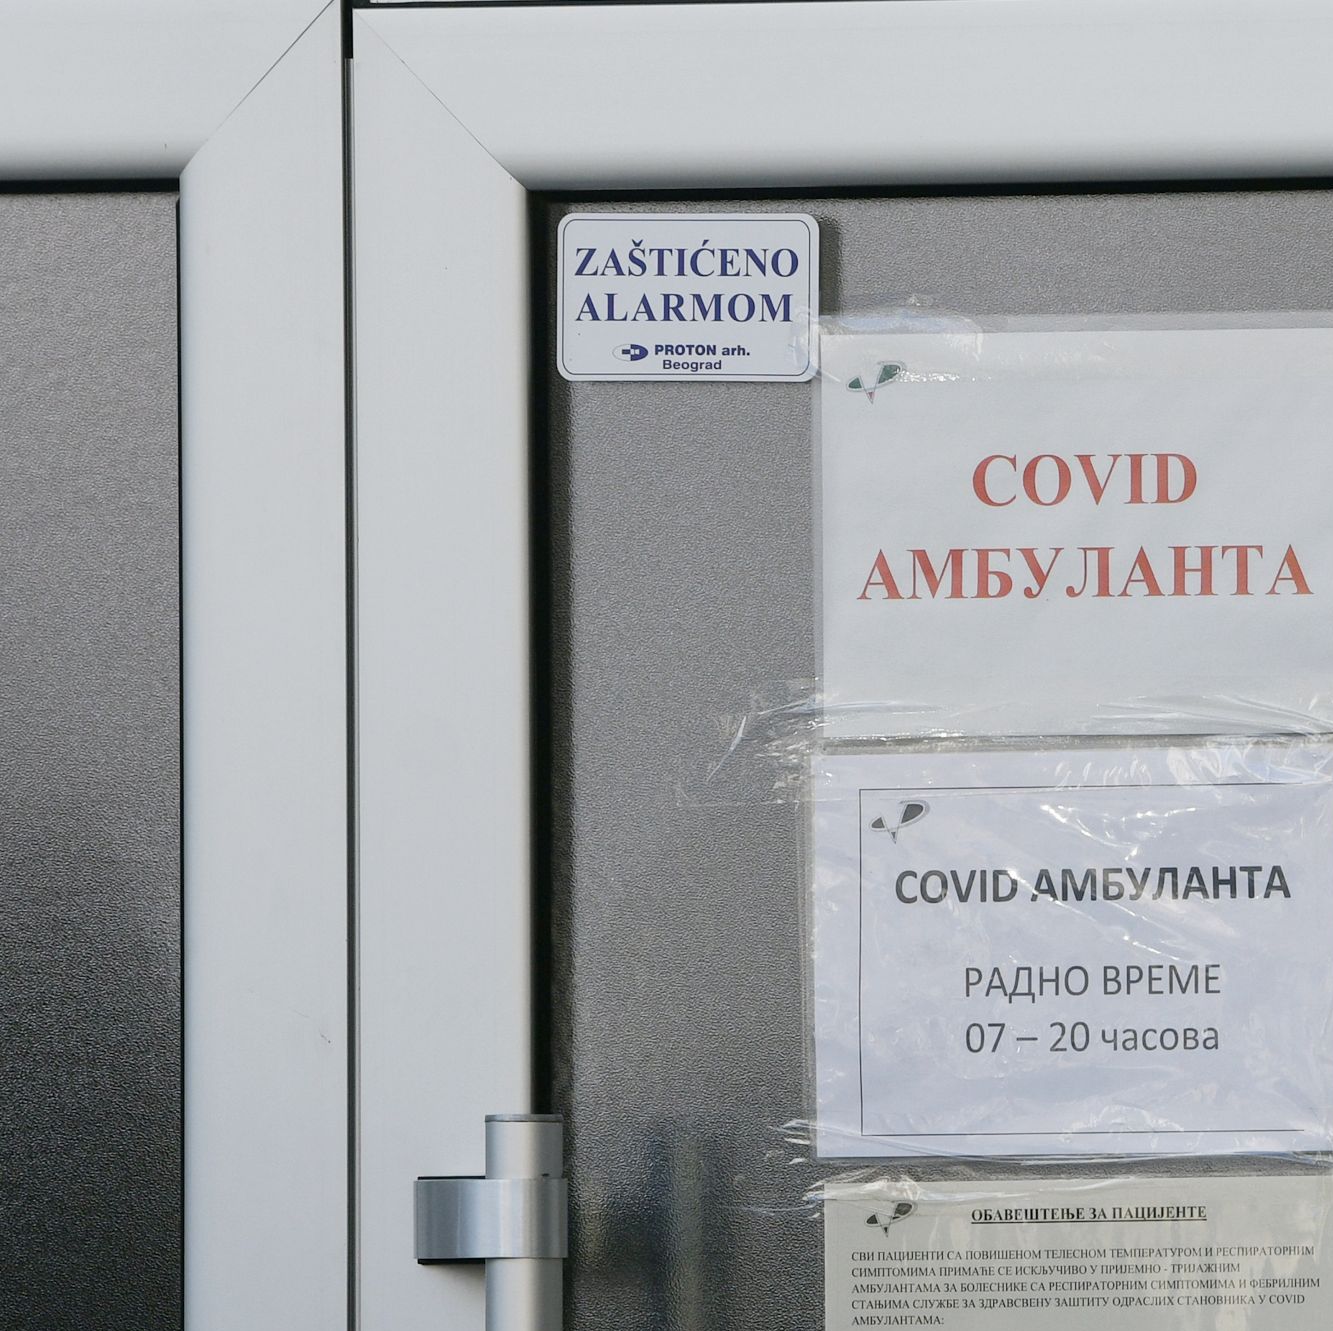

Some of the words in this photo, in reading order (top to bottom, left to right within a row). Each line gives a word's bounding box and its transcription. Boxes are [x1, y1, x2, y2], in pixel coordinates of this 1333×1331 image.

[574, 239, 800, 277] ZAŠTIĆENO
[574, 292, 793, 322] ALARMOM
[654, 344, 716, 356] PROTON
[721, 344, 750, 356] arh.
[662, 359, 722, 372] Beograd
[972, 453, 1198, 507] COVID
[857, 543, 1314, 602] АМБУЛАНТА
[895, 868, 1019, 905] COVID
[1030, 865, 1292, 902] АМБУЛАНТА
[965, 965, 1089, 1003] РАДНО
[1103, 964, 1220, 997] ВРЕМЕ
[965, 1022, 1005, 1053] 07
[1049, 1022, 1089, 1052] 20
[1101, 1027, 1218, 1051] часова
[971, 1207, 1085, 1221] ОБАВЕШТЕЊЕ
[1089, 1207, 1107, 1219] ЗА
[1112, 1205, 1206, 1220] ПАЦИЈЕНТЕ
[851, 1251, 874, 1262] СВИ
[877, 1250, 944, 1262] ПАЦИЈЕНТИ
[946, 1250, 962, 1260] СА
[965, 1249, 1041, 1260] ПОВИШЕНОМ
[1043, 1248, 1106, 1259] ТЕЛЕСНОМ
[1109, 1247, 1201, 1258] ТЕМПЕРАТУРОМ
[1204, 1247, 1213, 1257] И
[1216, 1246, 1314, 1256] РЕСПИРАТОРНИМ
[851, 1266, 936, 1278] СИМПТОМИМА
[939, 1266, 995, 1276] ПРИМАЋЕ
[997, 1265, 1012, 1276] СЕ
[1015, 1265, 1087, 1276] ИСКЉУЧИВО
[1089, 1264, 1097, 1274] У
[1100, 1264, 1161, 1274] ПРИЈЕМНО
[1170, 1263, 1240, 1273] ТРИЈАЖНИМ
[851, 1282, 941, 1294] АМБУЛАНТАМА
[943, 1282, 957, 1292] ЗА
[960, 1281, 1027, 1292] БОЛЕСНИКЕ
[1030, 1281, 1046, 1291] СА
[1048, 1280, 1147, 1291] РЕСПИРАТОРНИМ
[1150, 1279, 1235, 1290] СИМПТОМИМА
[1238, 1278, 1246, 1288] И
[1249, 1277, 1319, 1288] ФЕБРИЛНИМ
[851, 1298, 910, 1311] СТАЊИМА
[912, 1298, 959, 1309] СЛУЖБЕ
[961, 1298, 976, 1308] ЗА
[978, 1297, 1052, 1309] ЗДРАВСВЕНУ
[1054, 1296, 1109, 1307] ЗАШТИТУ
[1112, 1295, 1174, 1308] ОДРАСЛИХ
[1176, 1294, 1255, 1306] СТАНОВНИКА
[1258, 1294, 1266, 1304] У
[1268, 1294, 1305, 1304] COVID
[851, 1315, 944, 1325] АМБУЛАНТАМА:
